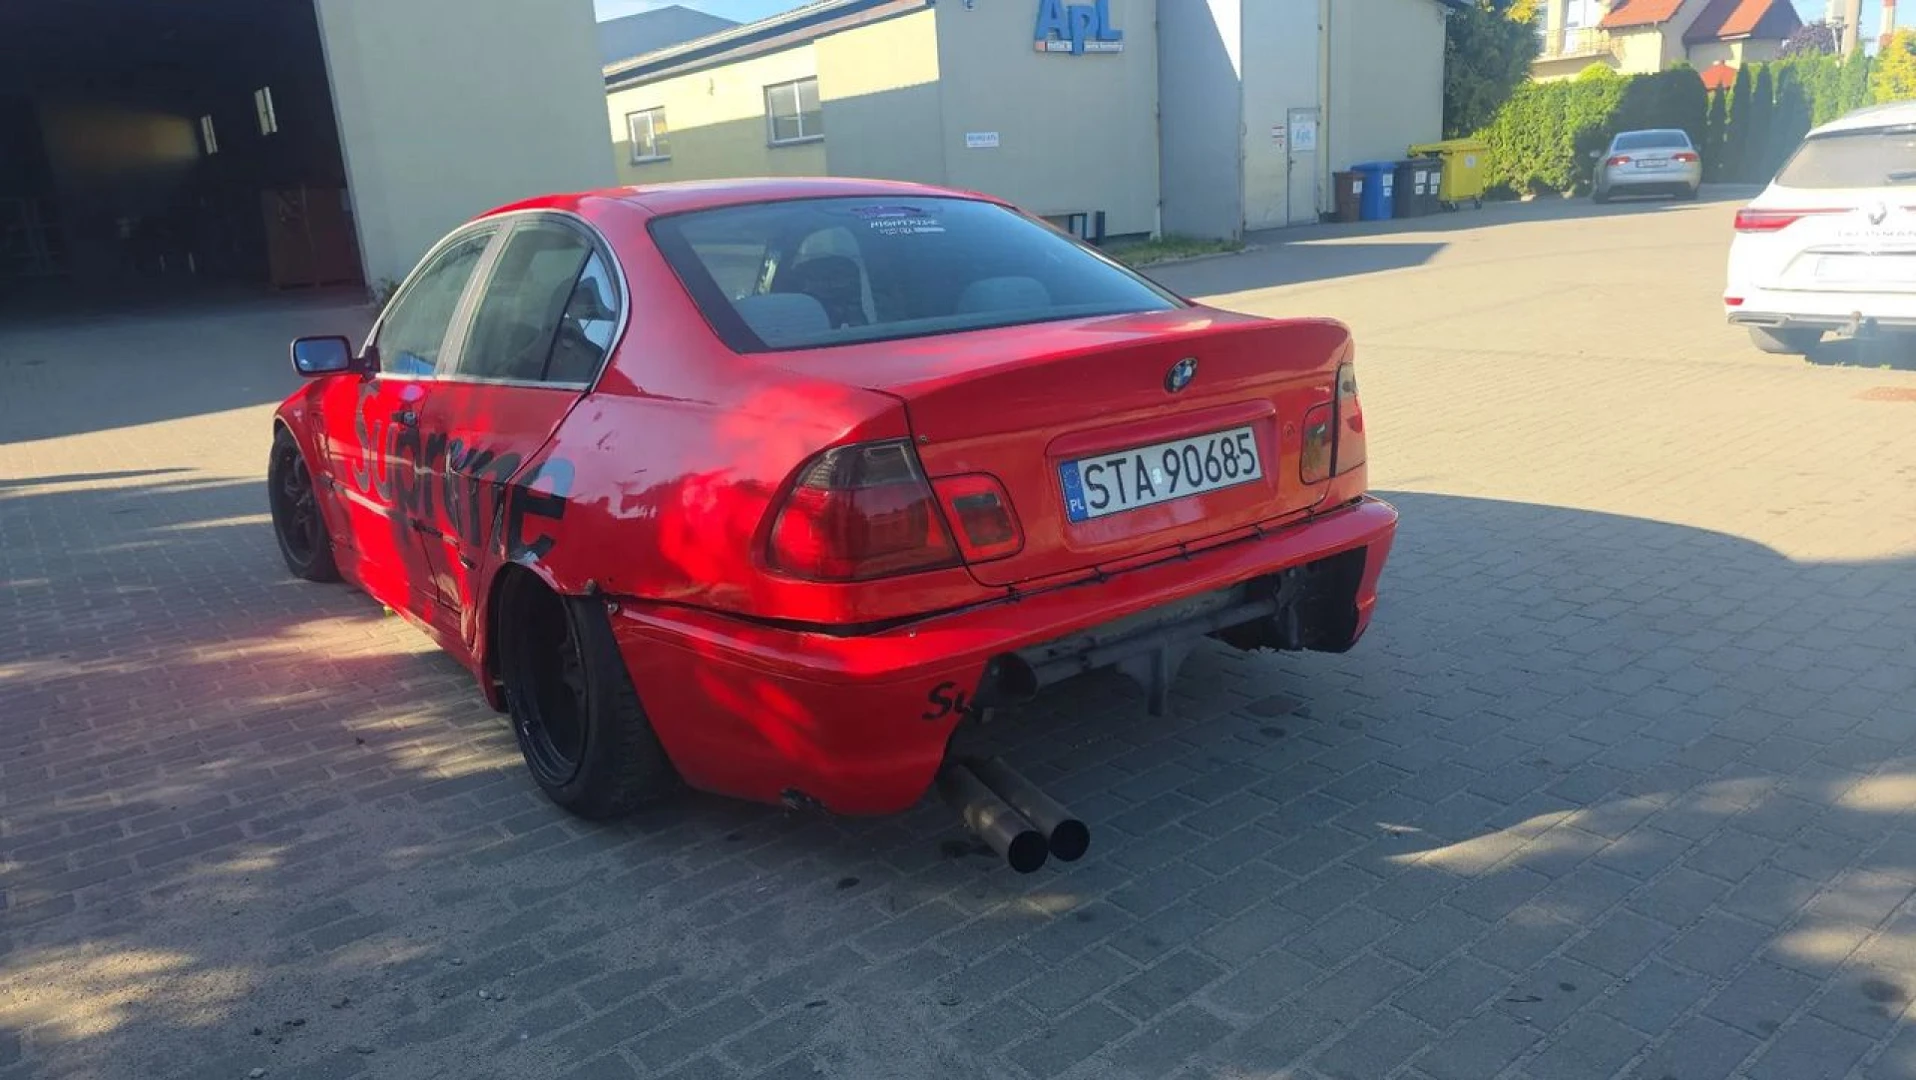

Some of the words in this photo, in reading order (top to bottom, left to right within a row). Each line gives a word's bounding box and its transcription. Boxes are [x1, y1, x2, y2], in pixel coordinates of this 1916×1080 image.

[1084, 454, 1156, 509] STA
[1162, 433, 1256, 494] 90685
[1069, 498, 1085, 513] PL
